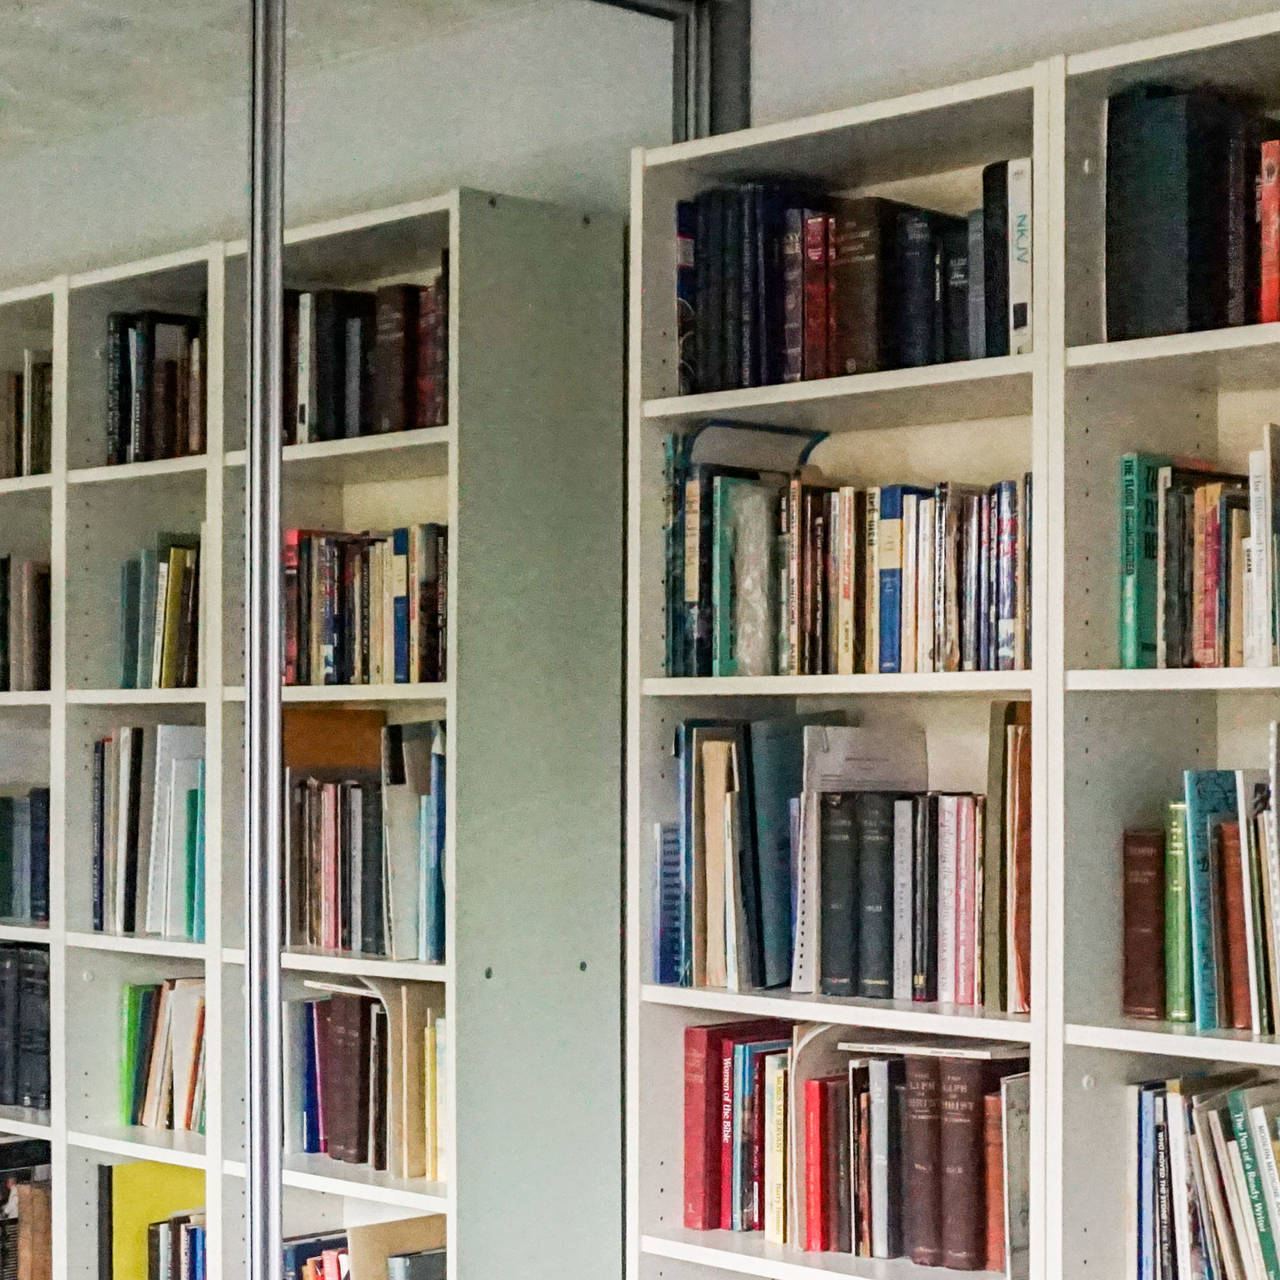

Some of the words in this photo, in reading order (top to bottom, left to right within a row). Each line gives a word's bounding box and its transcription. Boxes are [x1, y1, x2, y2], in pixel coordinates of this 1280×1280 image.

[723, 1058, 731, 1090] Women
[723, 1092, 731, 1103] of
[723, 1104, 731, 1119] the
[1234, 1112, 1245, 1130] The
[723, 1121, 731, 1144] Bible
[1238, 1133, 1248, 1148] Pen
[1241, 1152, 1250, 1163] of
[1246, 1172, 1259, 1200] Ready
[1254, 1203, 1267, 1232] Writer
